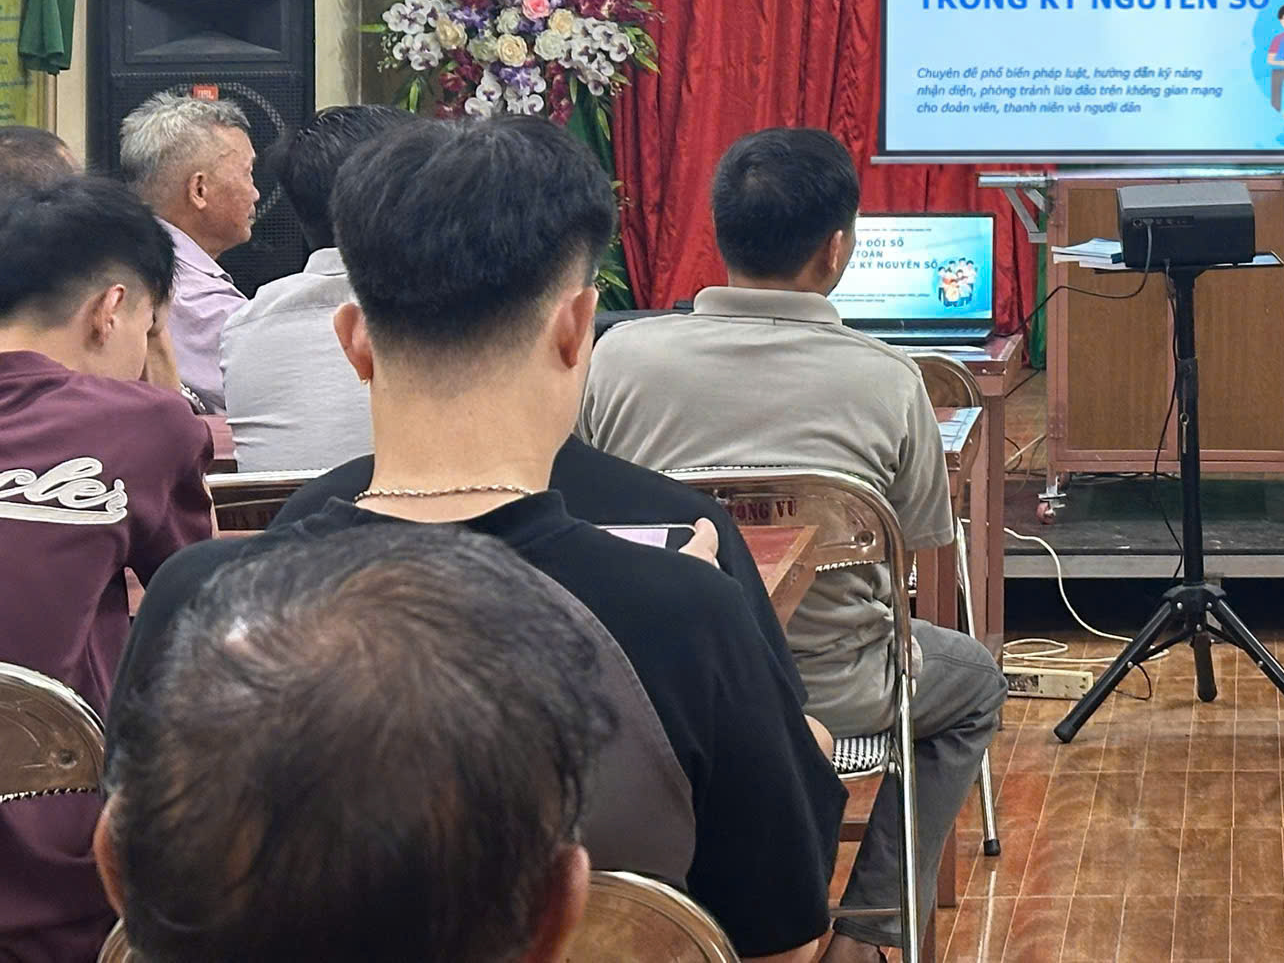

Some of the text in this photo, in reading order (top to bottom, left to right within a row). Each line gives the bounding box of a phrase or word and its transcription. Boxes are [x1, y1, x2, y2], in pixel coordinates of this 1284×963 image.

[1163, 85, 1188, 97] gian
[917, 102, 938, 113] cho
[1003, 102, 1037, 113] thanh
